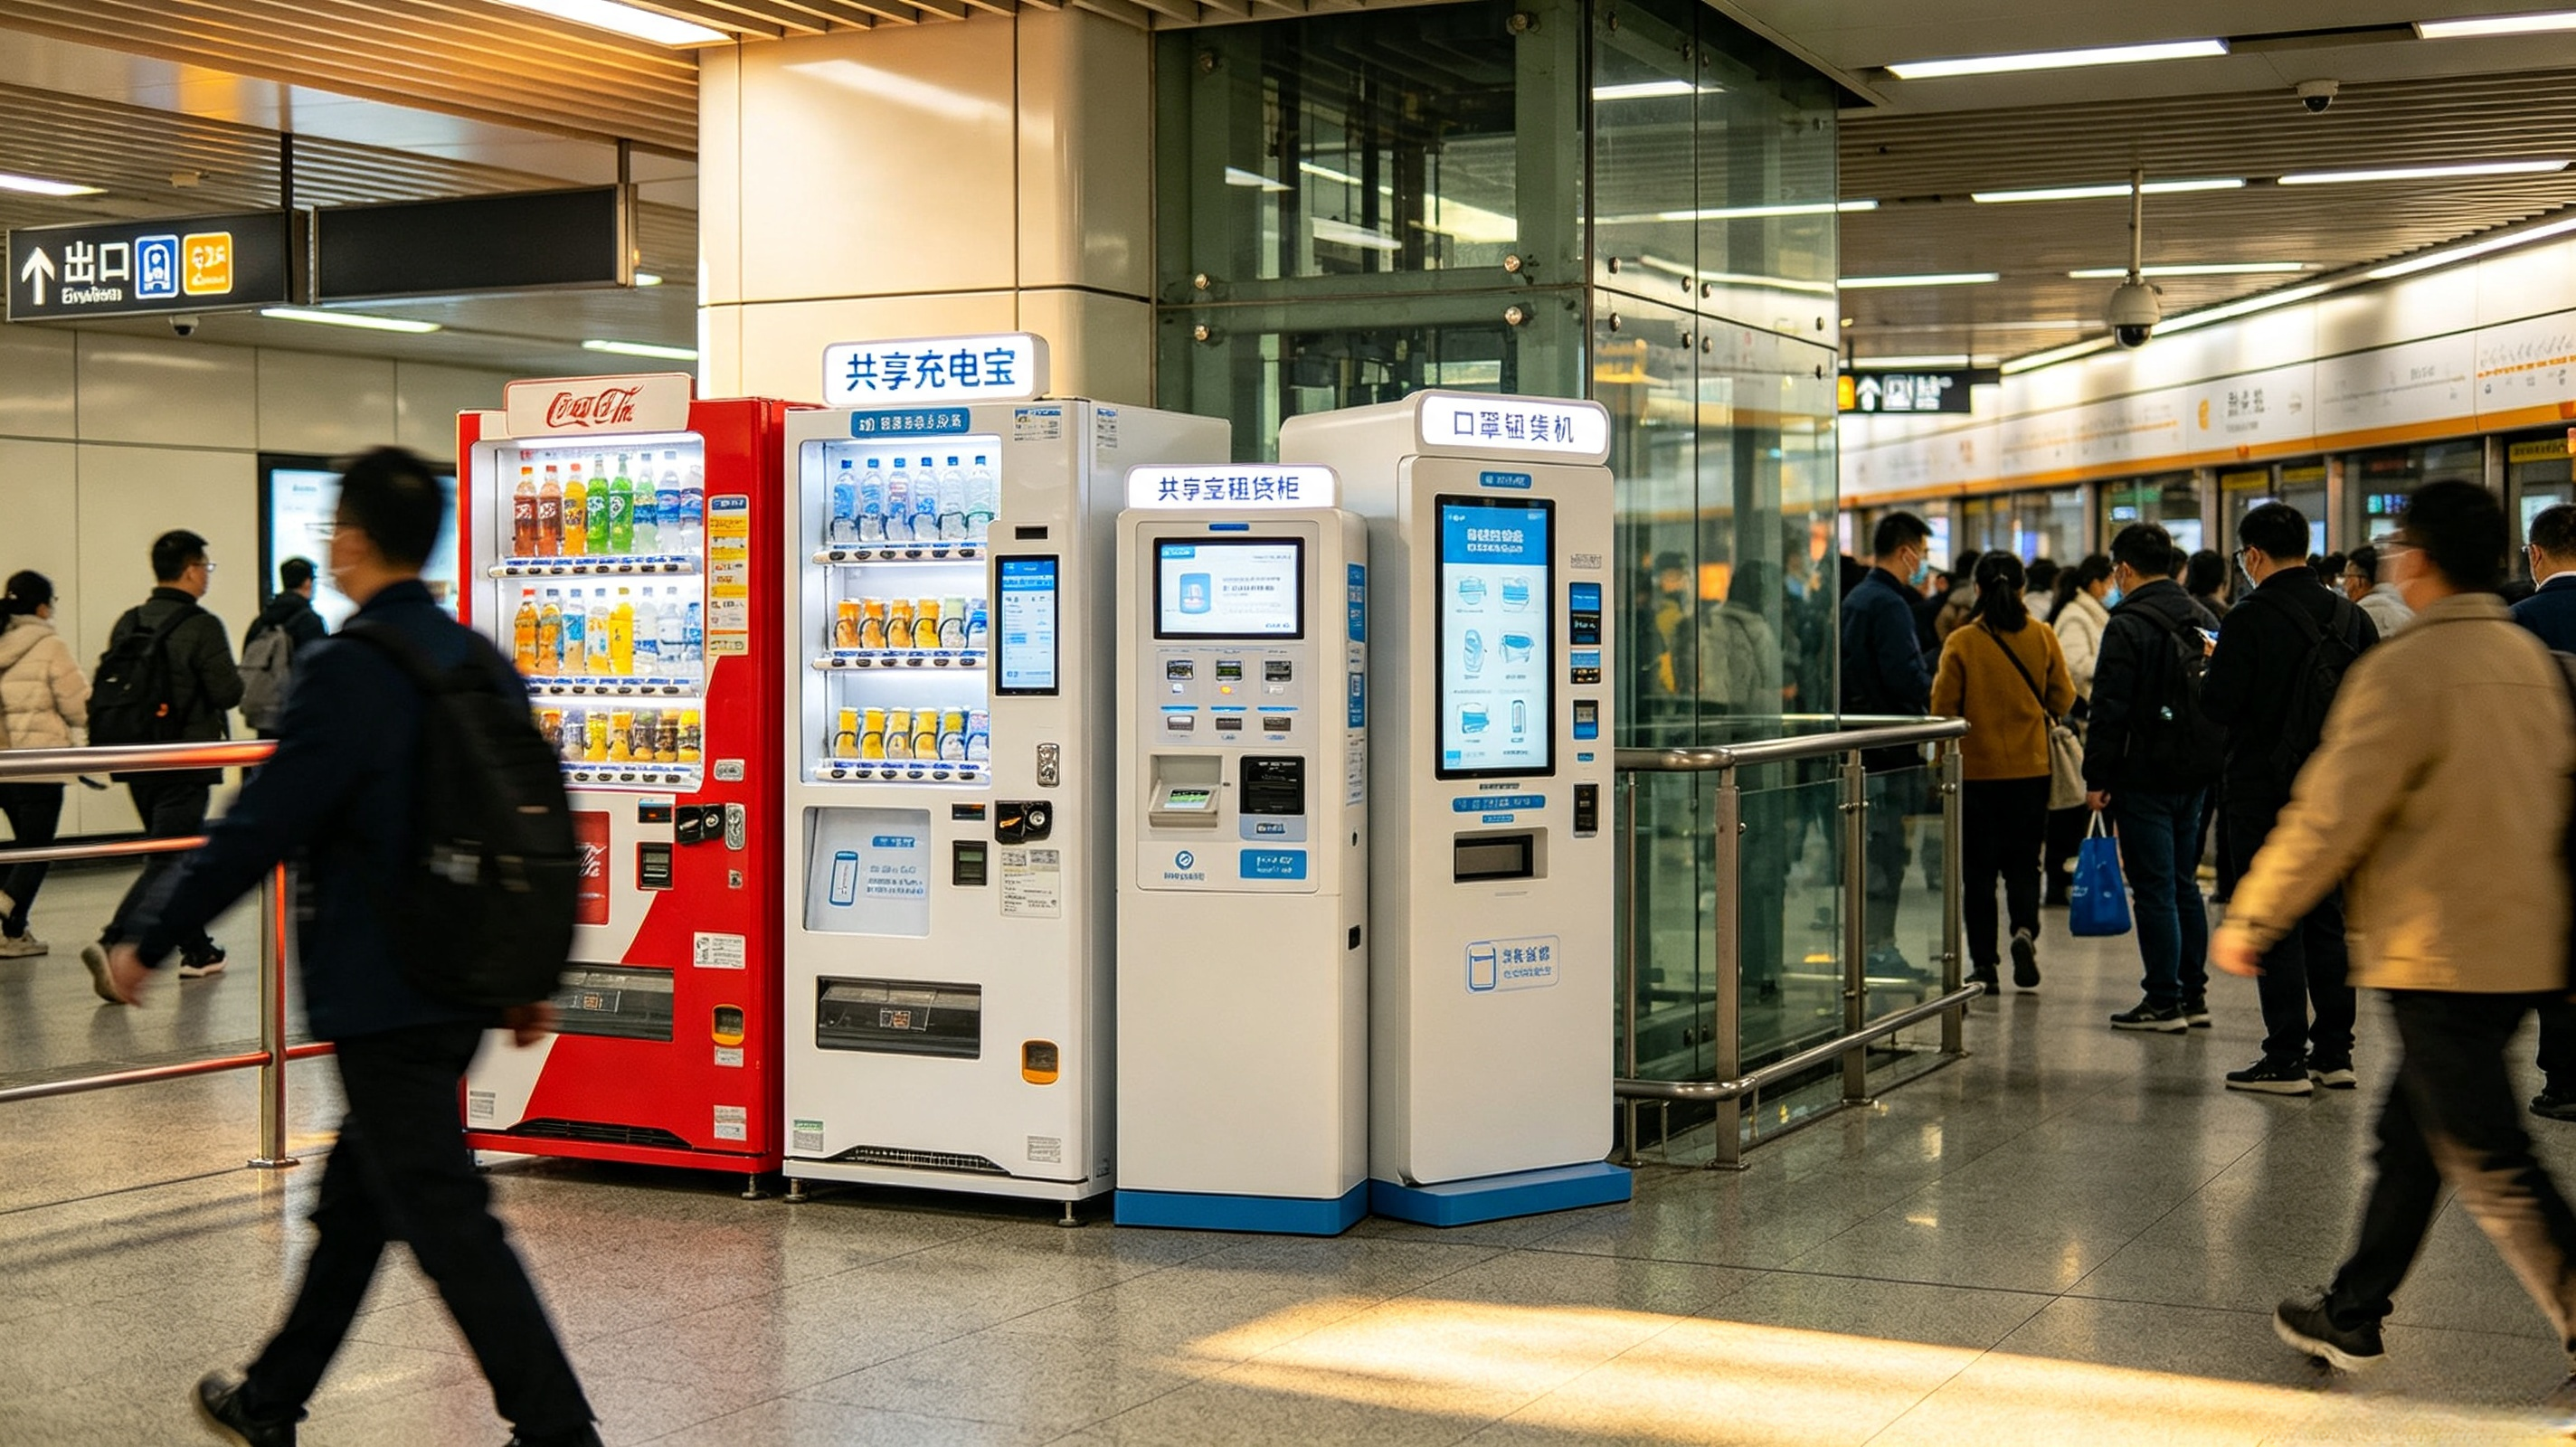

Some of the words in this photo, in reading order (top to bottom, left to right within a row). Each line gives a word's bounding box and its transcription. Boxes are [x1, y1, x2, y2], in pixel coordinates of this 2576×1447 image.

[64, 241, 130, 285] 出口
[846, 347, 1015, 392] 共享充电宝
